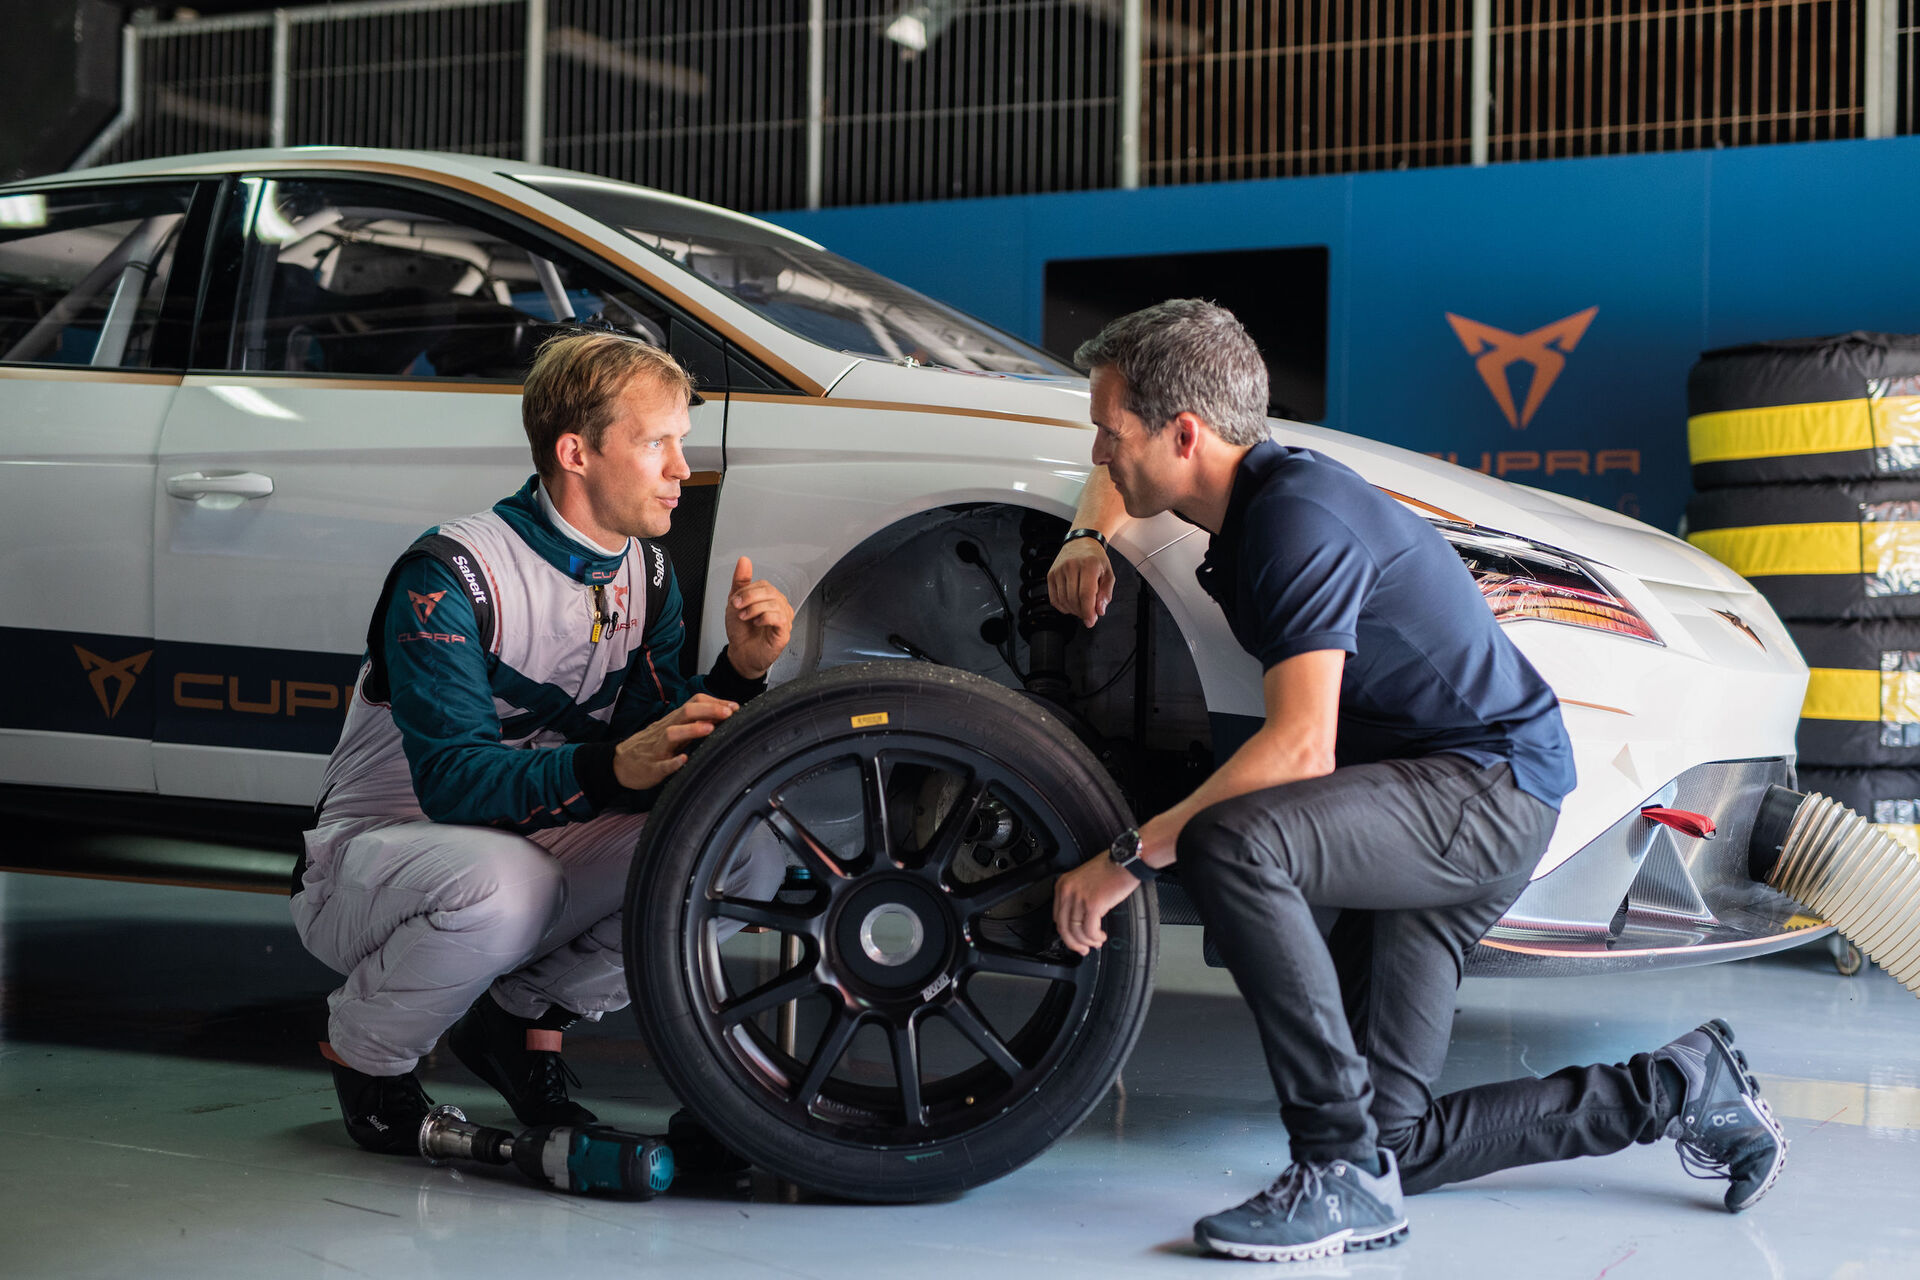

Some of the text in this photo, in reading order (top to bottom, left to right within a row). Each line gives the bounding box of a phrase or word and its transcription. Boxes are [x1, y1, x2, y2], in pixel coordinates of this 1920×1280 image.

[1421, 449, 1641, 476] UPRA
[452, 555, 487, 604] Sabelt
[649, 543, 665, 588] Sabelt
[173, 671, 355, 717] CUP
